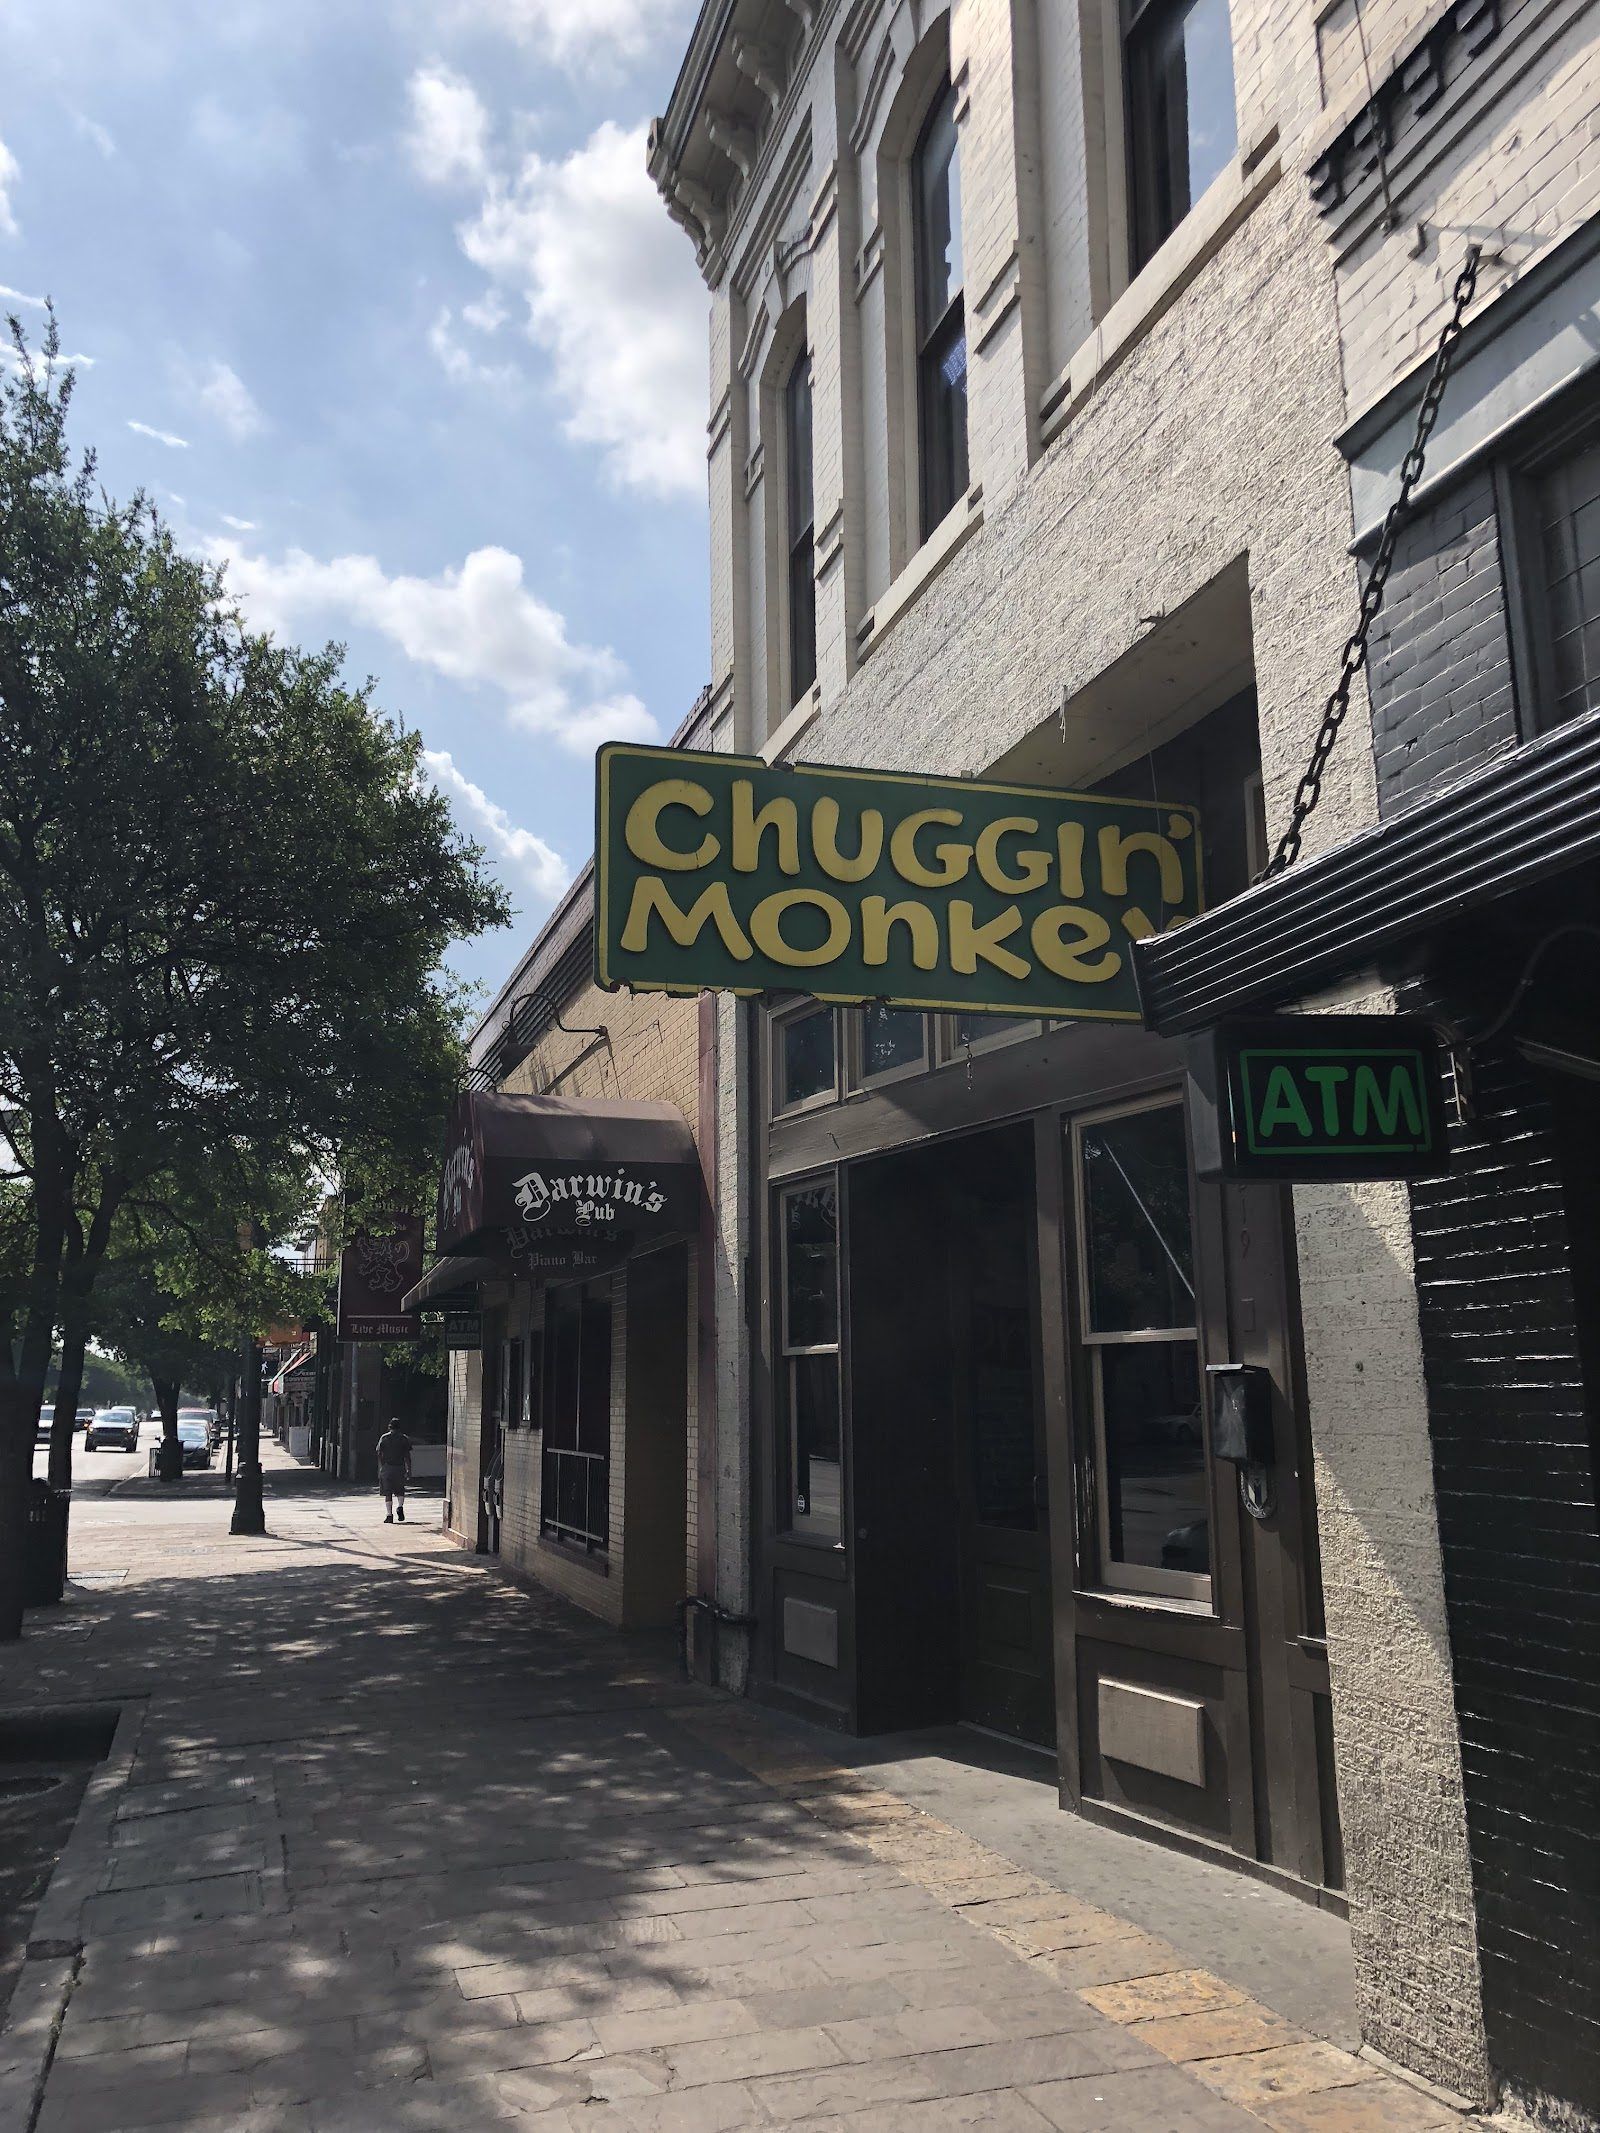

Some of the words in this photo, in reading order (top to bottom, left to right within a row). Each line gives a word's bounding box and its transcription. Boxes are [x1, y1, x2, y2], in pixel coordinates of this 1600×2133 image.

[1259, 1065, 1423, 1138] ATM
[512, 1167, 669, 1222] Darwin's
[575, 1199, 616, 1227] Pub
[527, 1252, 566, 1271] Piano
[571, 1250, 598, 1268] Bar
[350, 1323, 374, 1334] Live
[376, 1323, 409, 1334] Music
[448, 1319, 479, 1332] ATM
